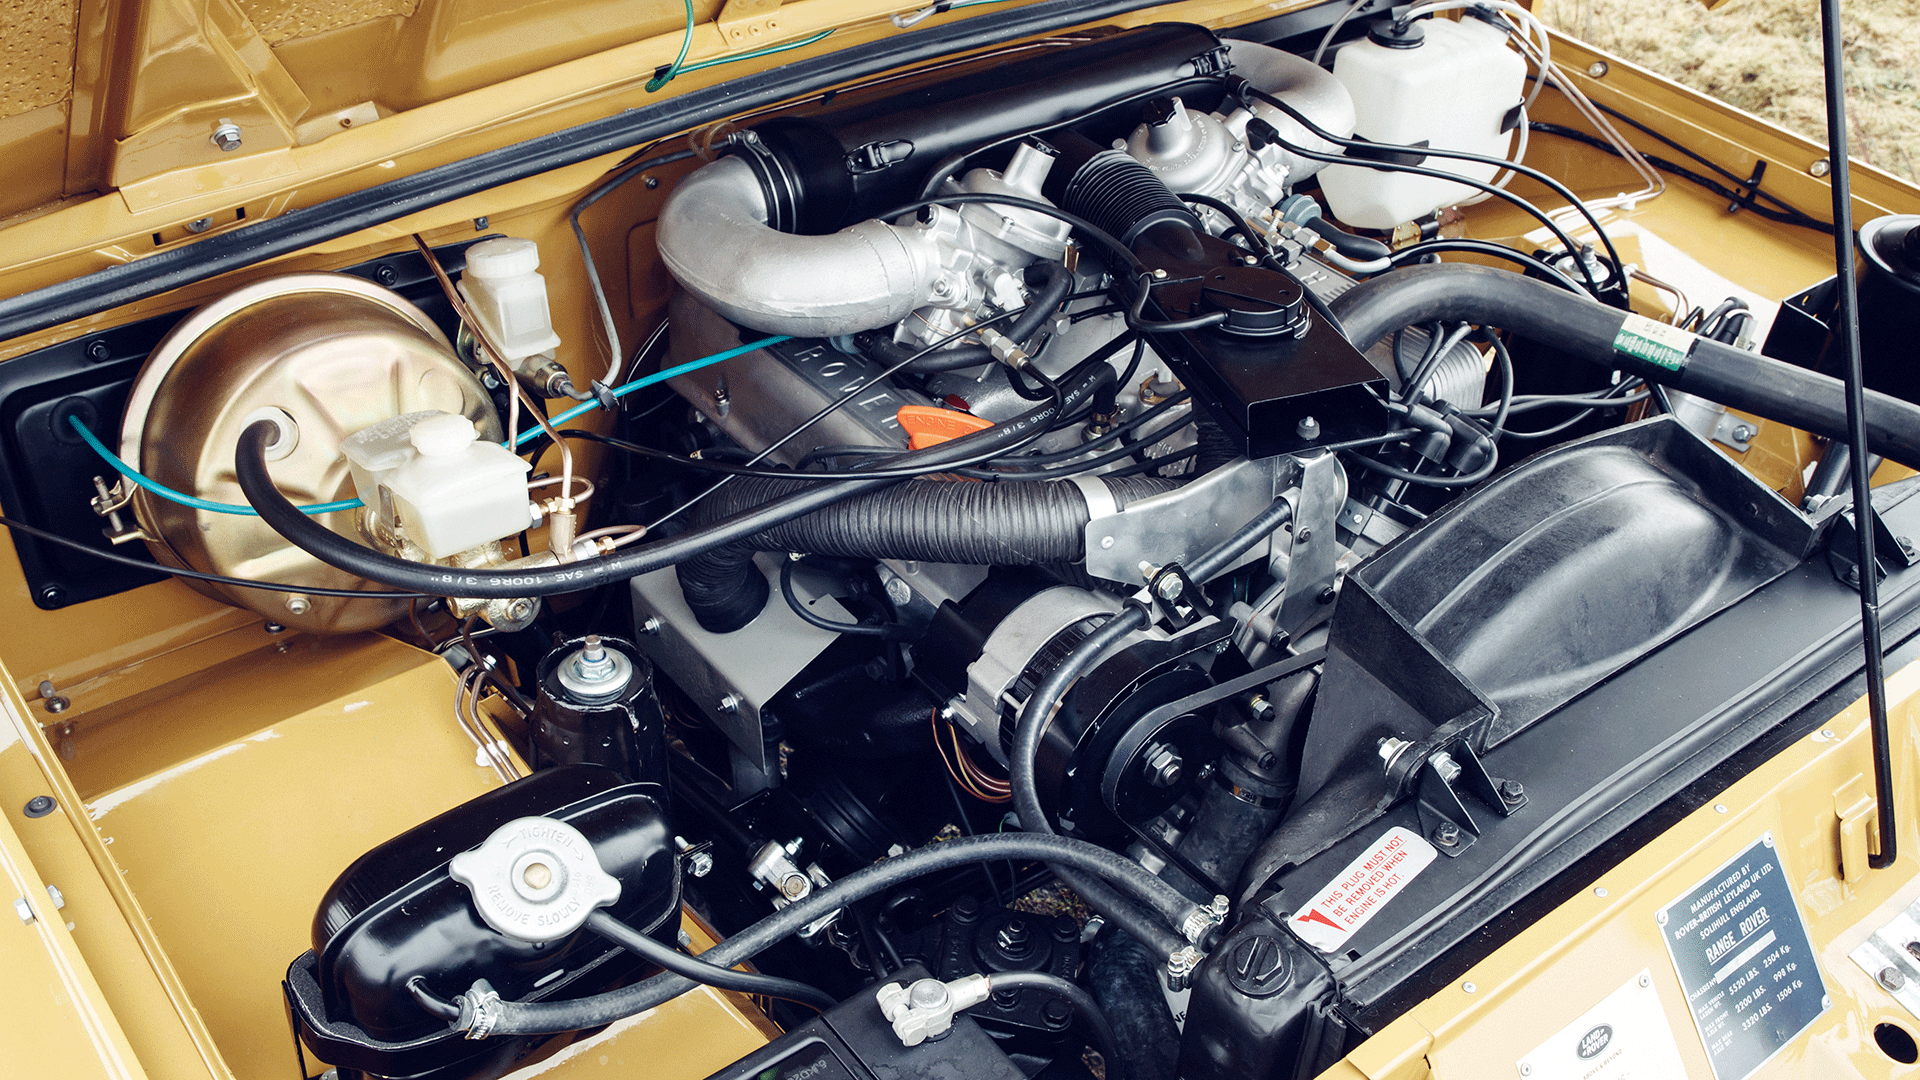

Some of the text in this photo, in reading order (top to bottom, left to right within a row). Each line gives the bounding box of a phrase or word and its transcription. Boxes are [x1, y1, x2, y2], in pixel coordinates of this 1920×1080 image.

[1064, 389, 1080, 405] SAE
[1030, 405, 1057, 424] 00R6
[490, 576, 543, 586] 100R6
[555, 570, 584, 582] SAE
[519, 827, 573, 847] TIGHTEN
[1320, 835, 1404, 909] THIS PLUG MUST NOT
[1333, 850, 1408, 917] BE REMOVED WHEN
[1674, 862, 1774, 940] ROVER-BRITISH LEYLAND UK LTD.
[1690, 863, 1751, 914] MANUFACTURED BY
[488, 885, 581, 926] REMOVE SLOWLY
[1344, 895, 1377, 925] ENGINE
[1374, 887, 1386, 898] IS
[1700, 913, 1731, 940] SOLIHULL
[1705, 931, 1737, 963] RANGE
[1728, 977, 1746, 995] 5520
[1745, 967, 1760, 982] LBS.
[1763, 950, 1780, 968] 2504
[1690, 982, 1710, 1001] CHASSIS
[1735, 995, 1752, 1013] 2200
[1752, 985, 1766, 999] LBS.
[1773, 968, 1786, 982] 998
[1742, 1012, 1759, 1031] 3320
[1759, 1002, 1772, 1017] LBS.
[1777, 986, 1792, 1002] 1506
[1582, 1029, 1600, 1049] LAND
[1586, 1033, 1609, 1056] ROVER
